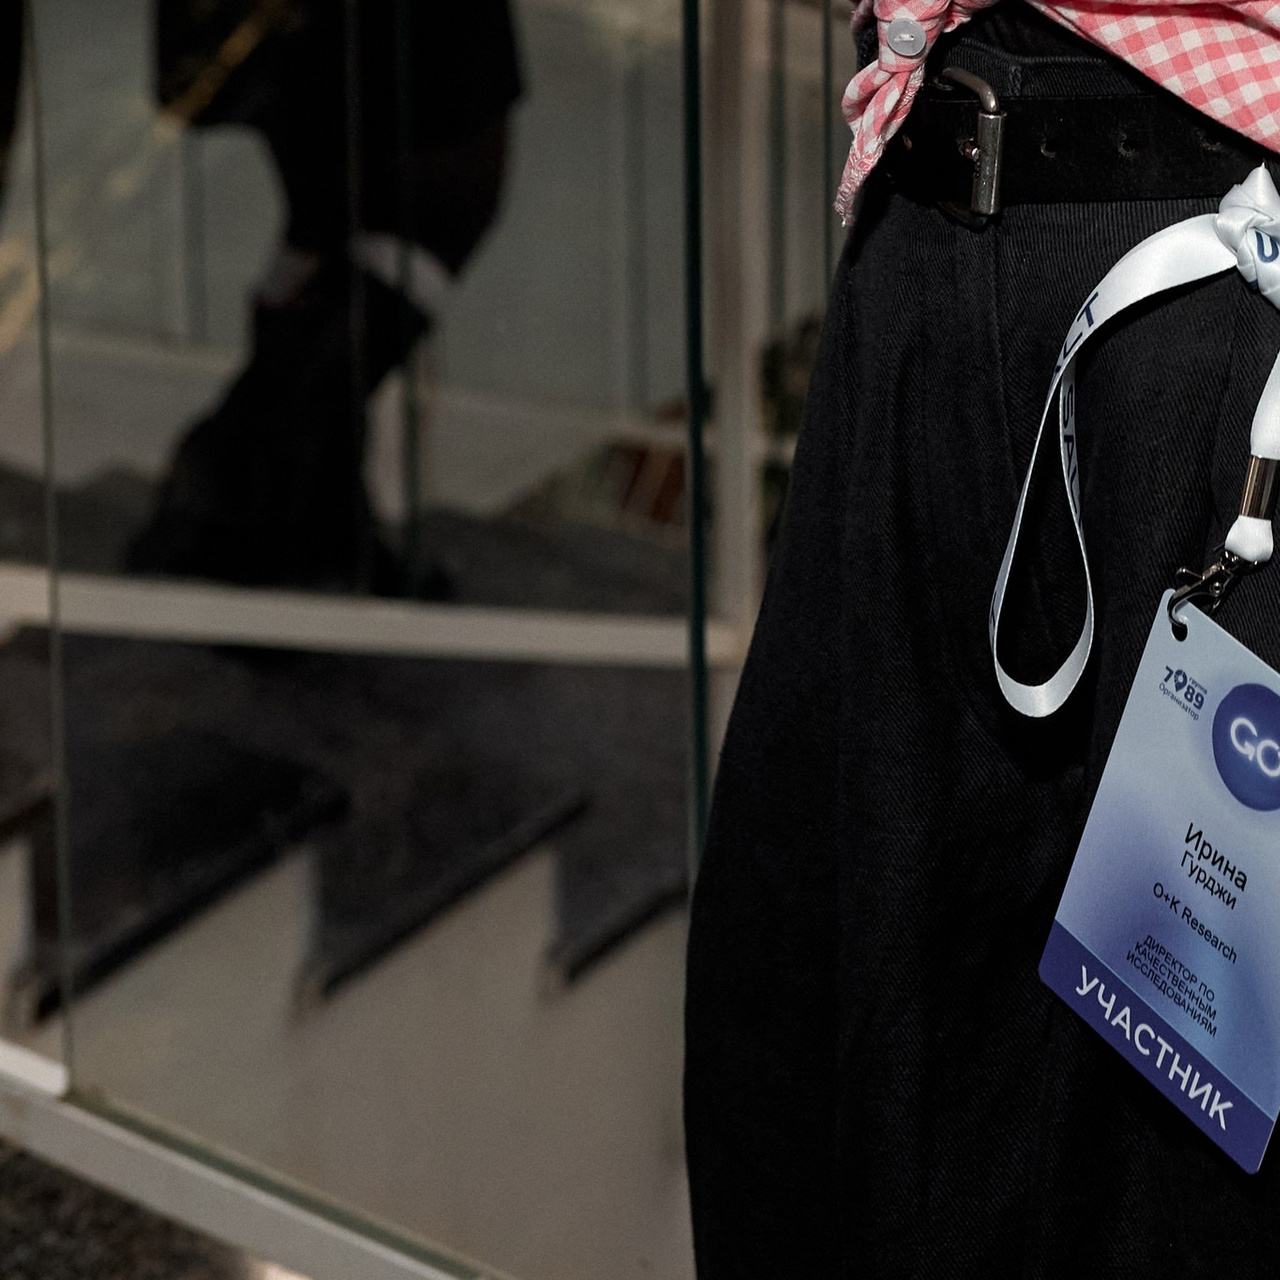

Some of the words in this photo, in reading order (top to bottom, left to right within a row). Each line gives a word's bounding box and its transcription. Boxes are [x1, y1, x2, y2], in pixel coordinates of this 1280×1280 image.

[1180, 850, 1237, 910] Гурджи
[1185, 822, 1248, 892] Ирина
[1153, 882, 1181, 915] O+K
[1181, 906, 1237, 964] Research
[1126, 950, 1217, 1037] ИССЛЕДОВАНИЯМ
[1134, 941, 1217, 1021] КАЧЕСТВЕННЫМ
[1143, 934, 1198, 985] ДИРЕКТОР
[1198, 982, 1215, 1002] ПО
[1075, 964, 1234, 1131] УЧАСТНИК
